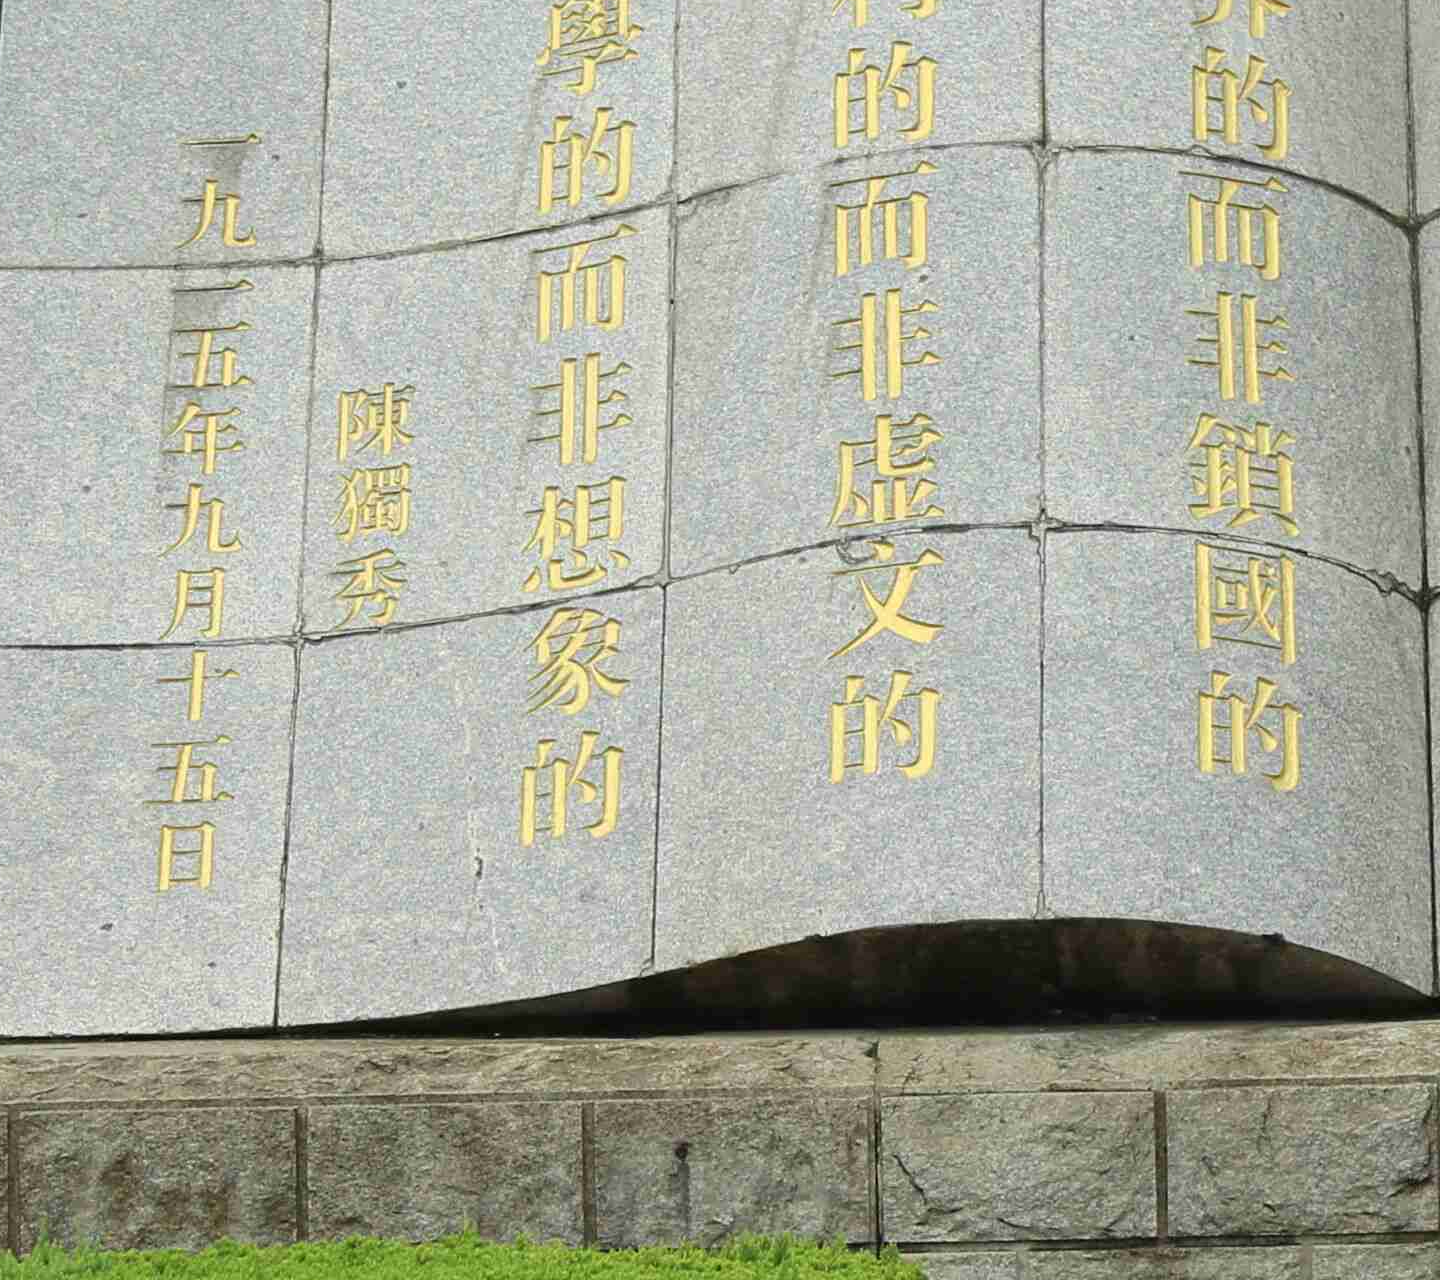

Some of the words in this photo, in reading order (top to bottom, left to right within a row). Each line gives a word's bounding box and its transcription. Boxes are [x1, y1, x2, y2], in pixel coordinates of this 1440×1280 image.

[143, 133, 261, 889] 一九一五年九月十五日
[332, 382, 415, 627] 陳獨秀
